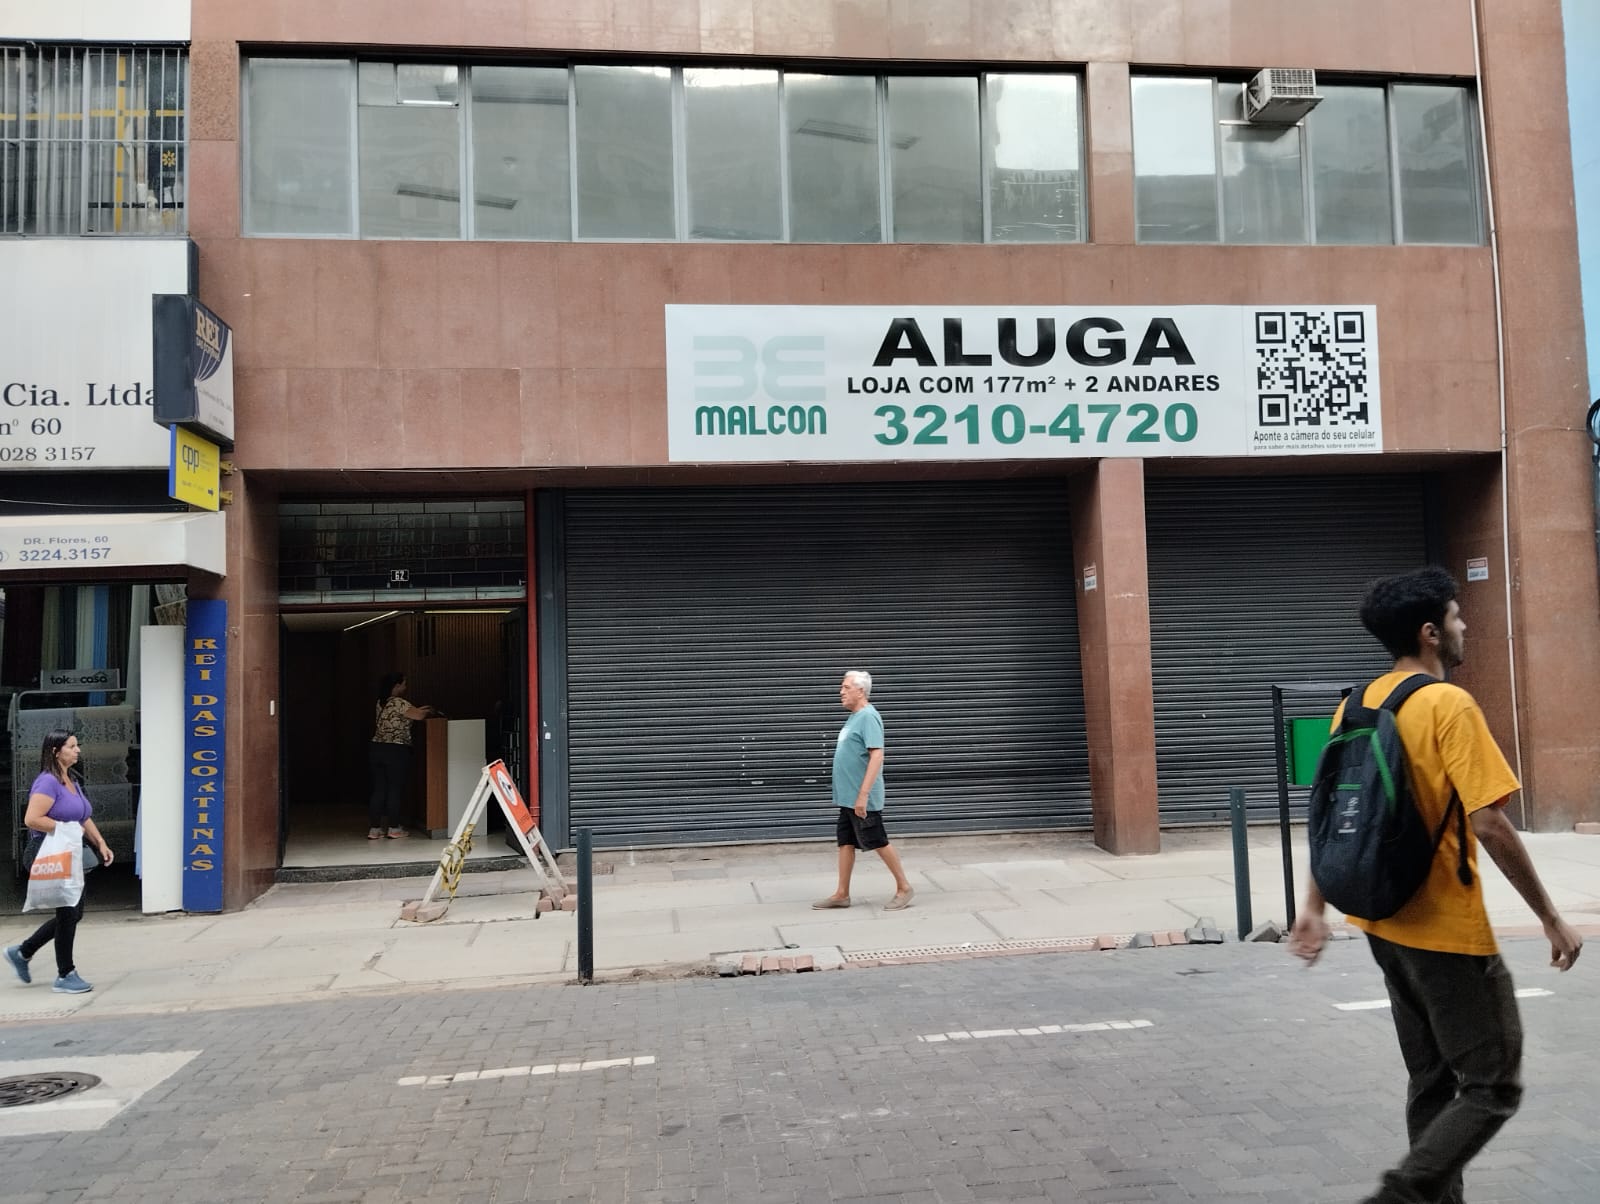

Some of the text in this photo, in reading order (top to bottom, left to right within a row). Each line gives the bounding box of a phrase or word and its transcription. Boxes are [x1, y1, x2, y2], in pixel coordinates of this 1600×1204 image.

[872, 316, 1196, 367] ALUGA
[3, 382, 71, 407] Cia.
[847, 376, 911, 394] LOJA
[919, 376, 974, 394] COM
[983, 375, 1056, 393] 177m²
[1085, 376, 1099, 393] 2
[1106, 374, 1220, 393] ANDARES
[31, 417, 62, 436] 60
[695, 405, 827, 436] MALCON
[873, 402, 1198, 446] 3210-4720
[1253, 429, 1376, 444] Aponte a câmera do seu celular
[45, 446, 96, 461] 3157
[182, 445, 200, 473] cpp
[23, 537, 45, 545] DR.
[94, 535, 109, 543] 60
[19, 547, 111, 562] 3224.3157
[193, 638, 218, 681] REI
[192, 694, 218, 737] DAS
